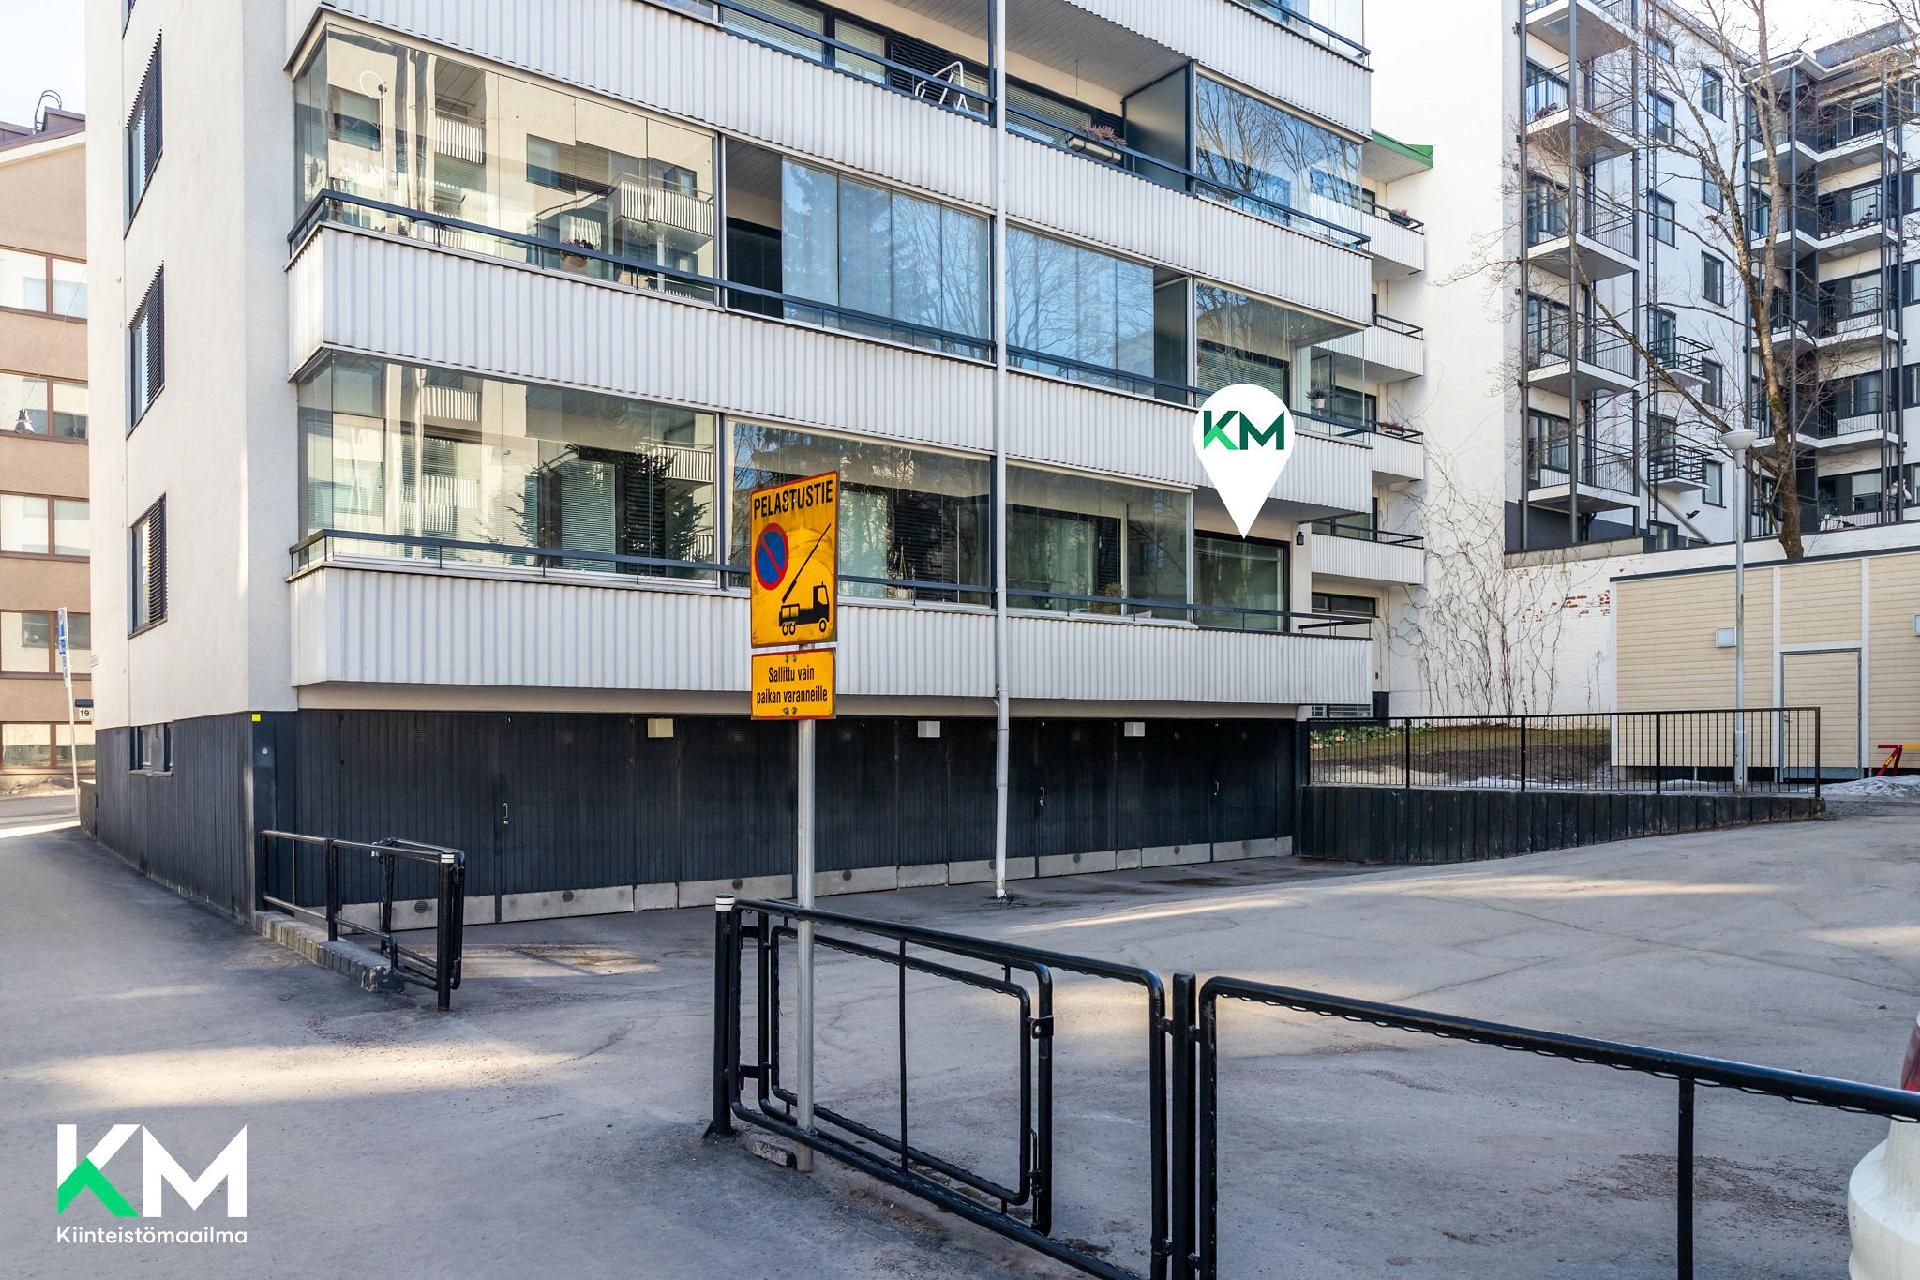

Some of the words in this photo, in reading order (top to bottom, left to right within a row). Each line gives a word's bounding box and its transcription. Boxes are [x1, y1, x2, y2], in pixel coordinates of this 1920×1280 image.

[754, 480, 833, 520] PELASTUSTIE
[768, 666, 795, 683] Sallittu
[797, 664, 815, 680] vain
[757, 688, 781, 708] paikan
[783, 685, 828, 703] varanneille
